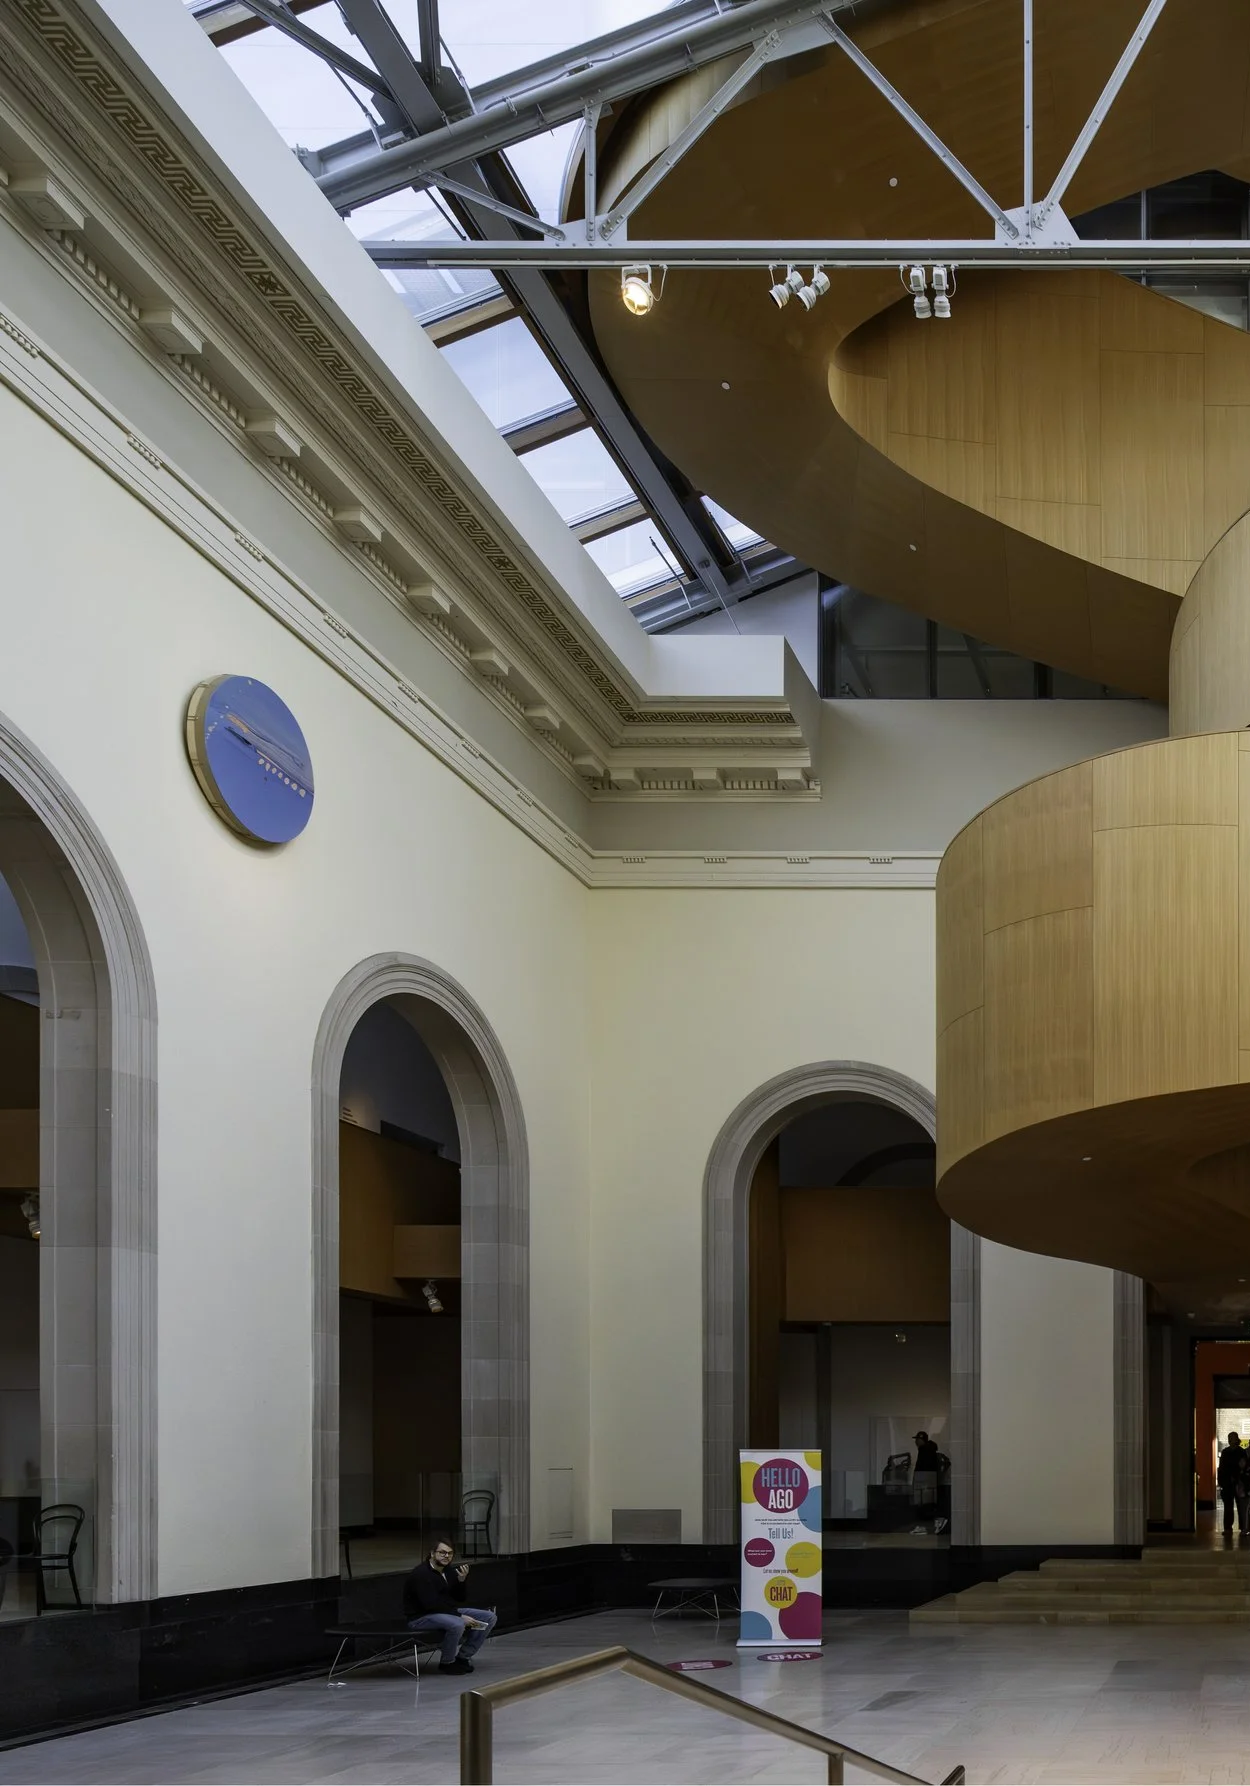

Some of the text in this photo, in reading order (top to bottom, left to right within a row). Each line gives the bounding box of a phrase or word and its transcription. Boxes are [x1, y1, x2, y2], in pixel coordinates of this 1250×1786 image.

[762, 1468, 800, 1487] HELLO
[768, 1490, 793, 1508] AGO
[768, 1527, 794, 1539] Tell Us!
[770, 1587, 792, 1601] CHAT
